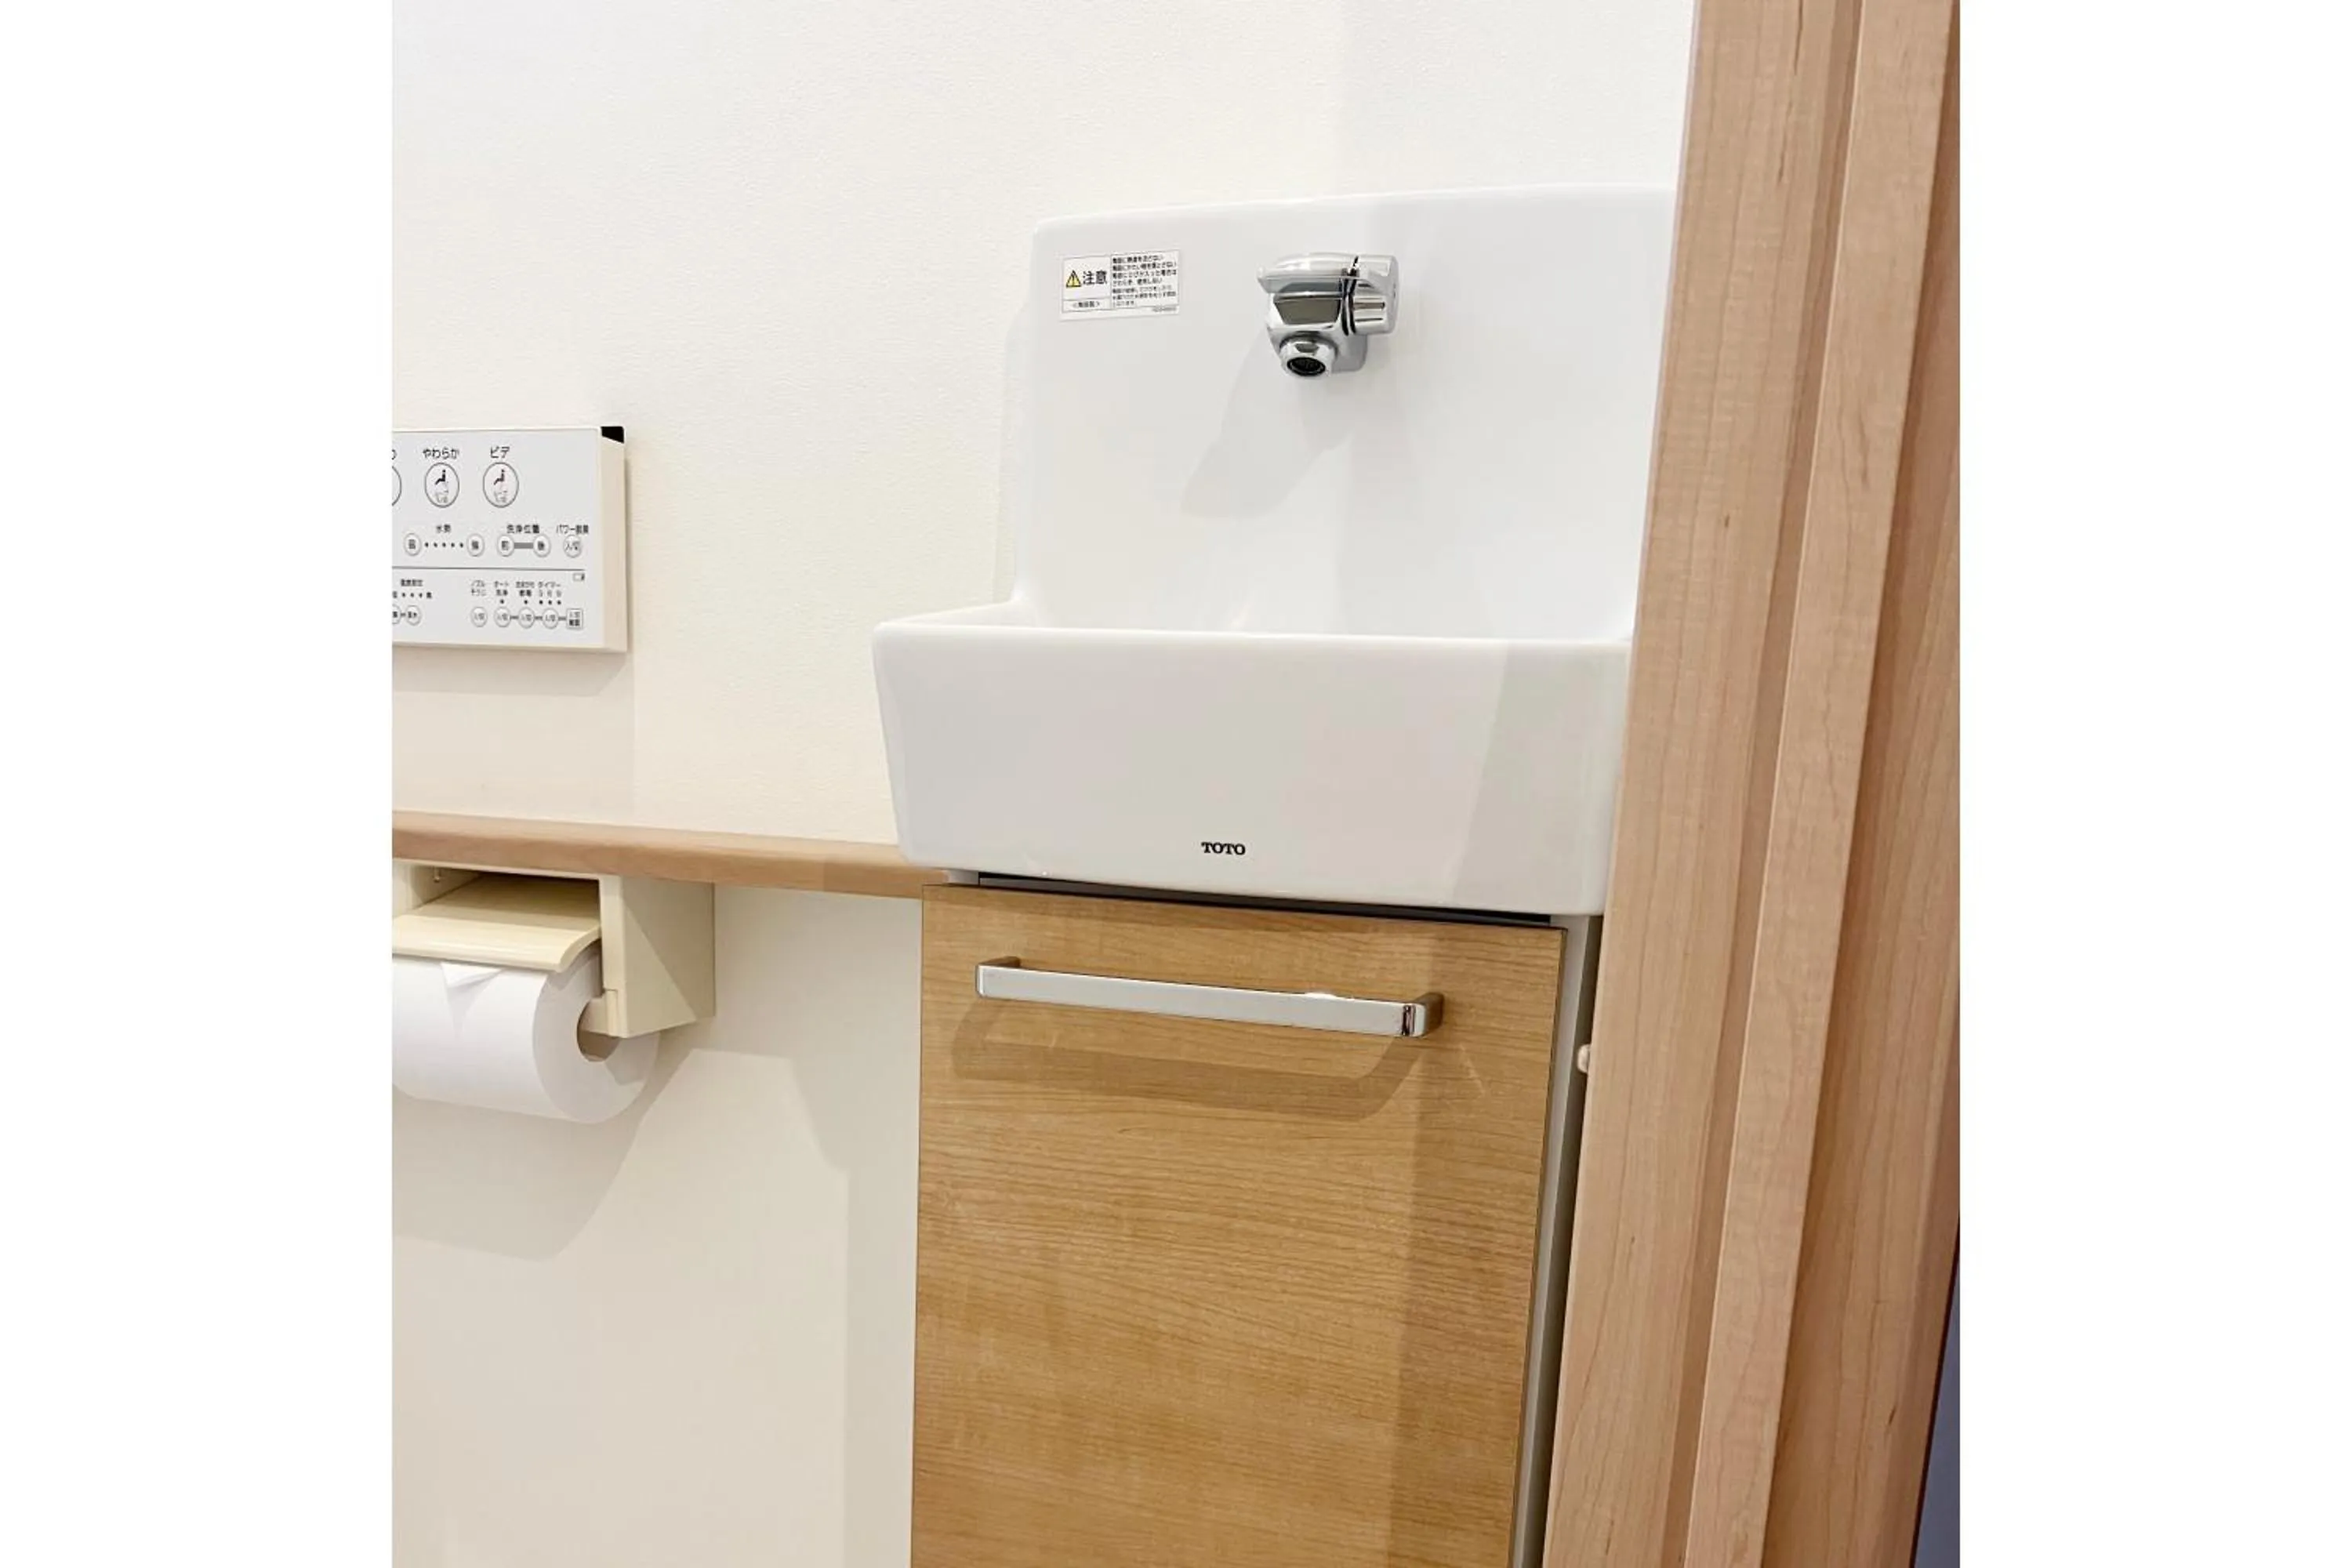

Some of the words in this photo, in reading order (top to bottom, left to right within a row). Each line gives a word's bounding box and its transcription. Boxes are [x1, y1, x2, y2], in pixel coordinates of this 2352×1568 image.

[1083, 270, 1107, 285] 注意
[423, 448, 459, 459] やわらか
[490, 446, 510, 459] ビデ
[1201, 841, 1246, 855] TOTO
